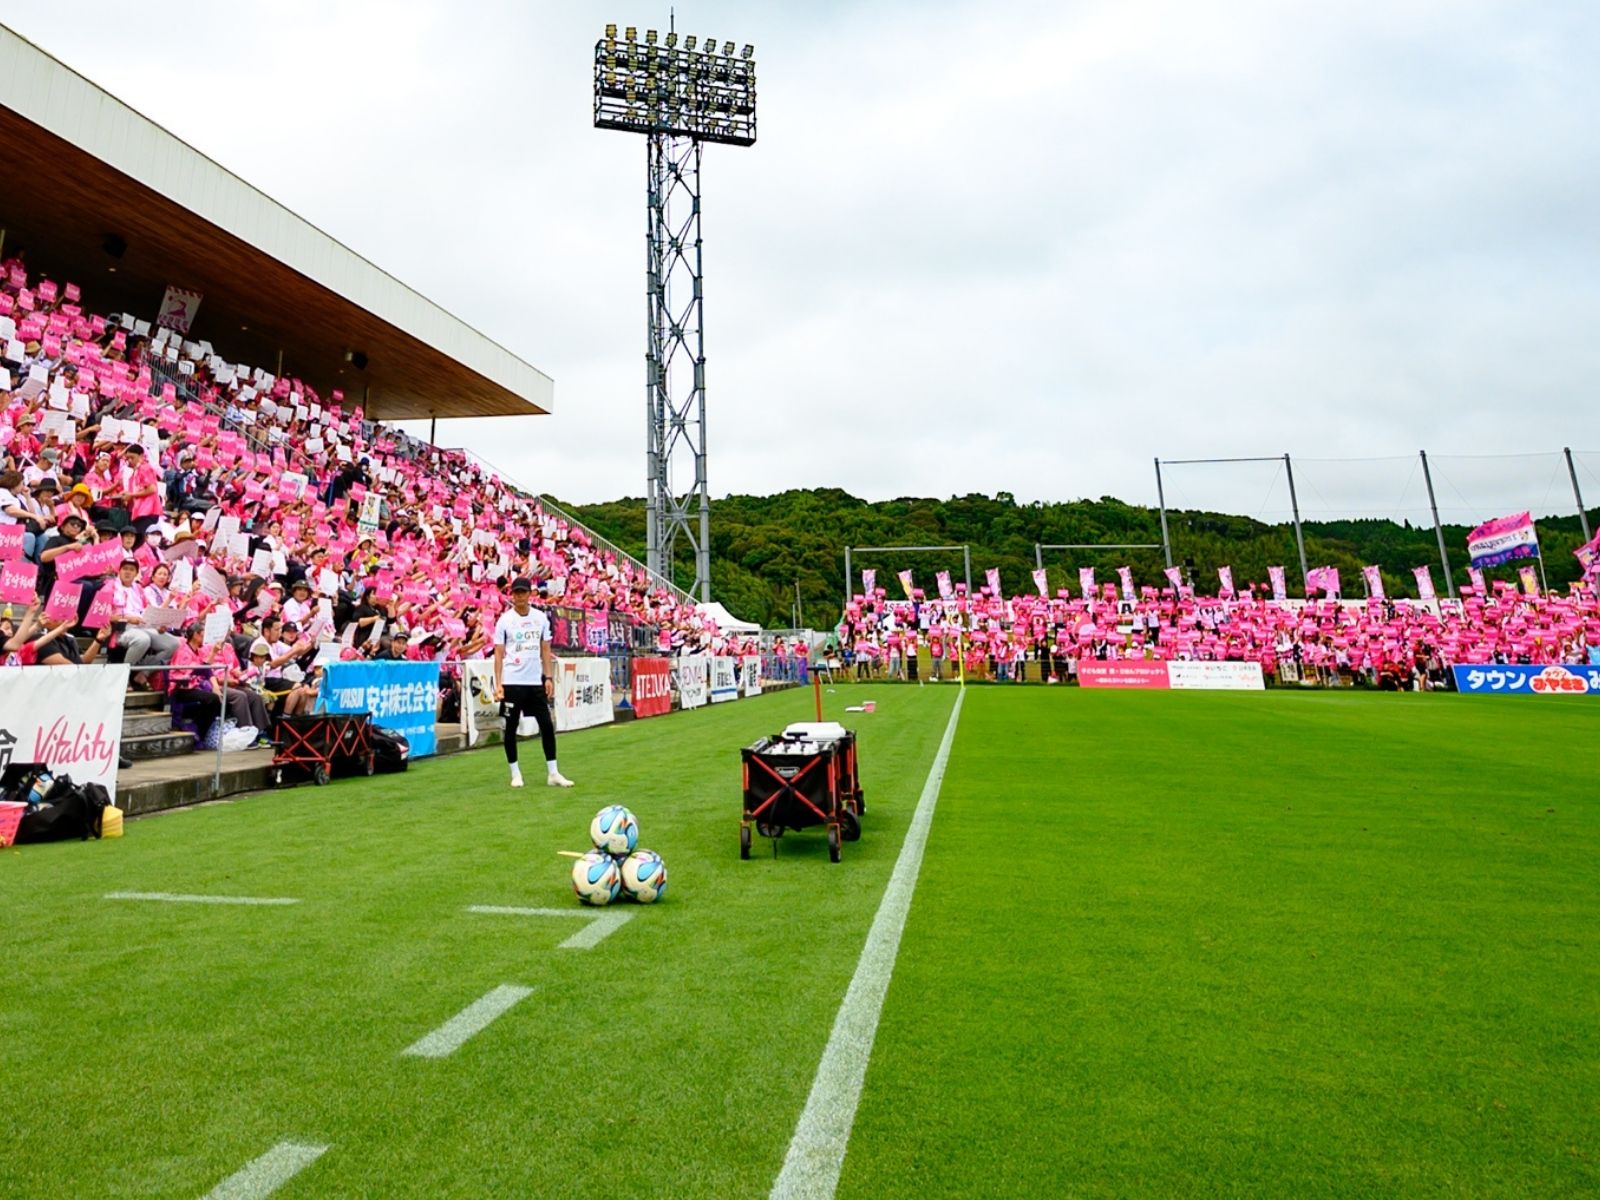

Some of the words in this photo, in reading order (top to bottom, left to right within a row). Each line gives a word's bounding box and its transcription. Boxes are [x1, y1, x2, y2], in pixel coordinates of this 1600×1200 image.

[524, 630, 541, 640] GTS
[641, 673, 671, 699] TEZUKA
[1467, 670, 1526, 690] タウン
[366, 681, 438, 718] 安井株式会社
[33, 714, 115, 776] Vitality
